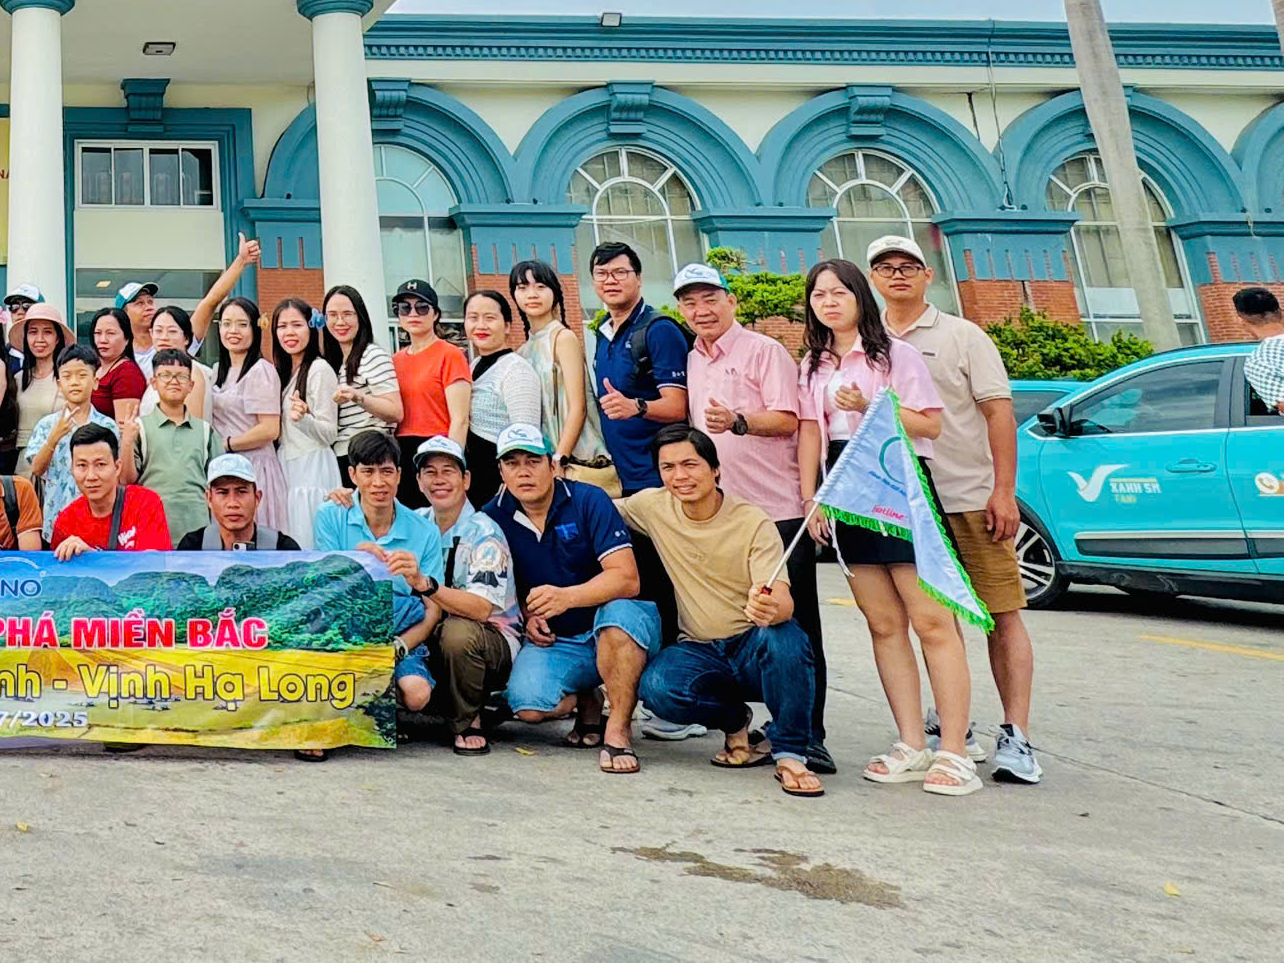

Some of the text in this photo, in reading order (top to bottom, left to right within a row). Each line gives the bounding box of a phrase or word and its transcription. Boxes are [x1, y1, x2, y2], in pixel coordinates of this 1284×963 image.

[70, 608, 176, 650] MIỀN
[186, 607, 269, 651] BẮC
[51, 677, 69, 691] -
[76, 664, 172, 710] Vịnh
[183, 664, 245, 712] Hạ
[257, 664, 356, 711] Long
